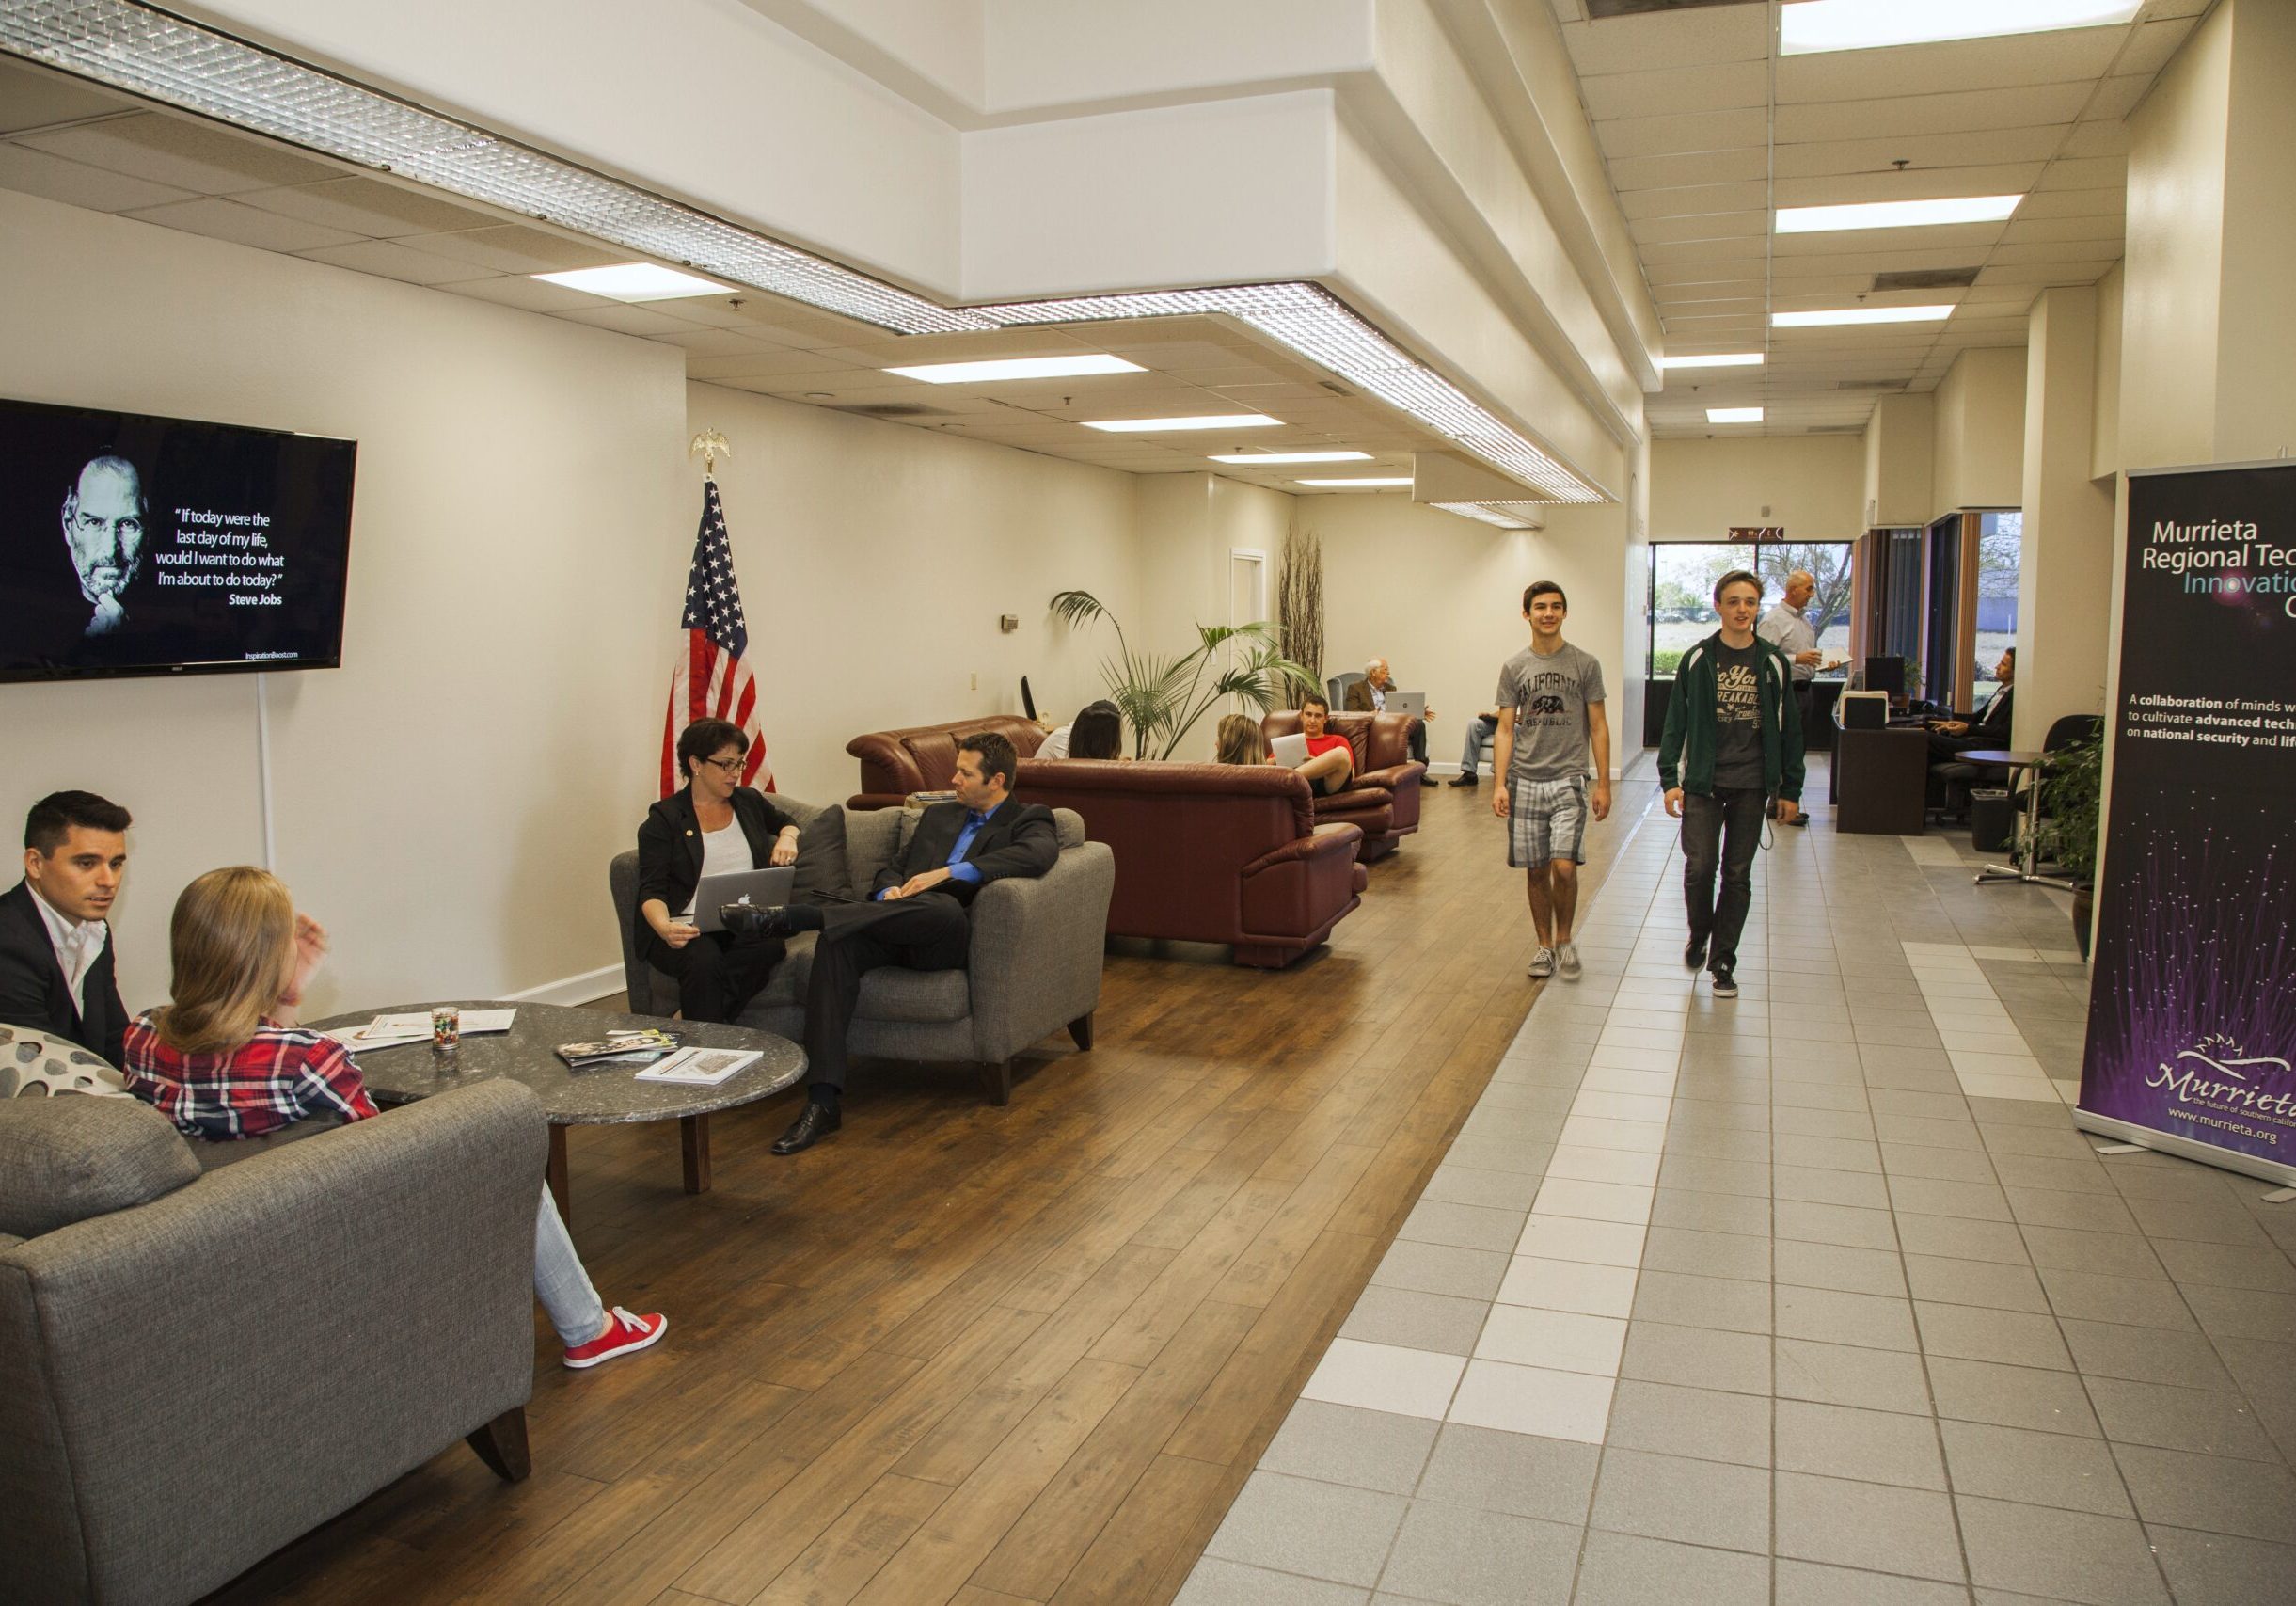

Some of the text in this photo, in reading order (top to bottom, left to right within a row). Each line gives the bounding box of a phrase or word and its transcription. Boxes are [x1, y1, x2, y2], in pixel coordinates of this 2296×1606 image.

[191, 509, 223, 527] today
[225, 515, 251, 526] were
[252, 513, 270, 527] the
[176, 529, 268, 549] last day of my life,
[2152, 519, 2258, 543] Murrieta
[155, 550, 284, 566] would I want to do what
[2142, 544, 2249, 574] Regional
[158, 572, 175, 585] I'm
[177, 571, 211, 586] about
[213, 574, 224, 586] to
[226, 572, 240, 586] do
[229, 593, 282, 605] Steve Jobs
[1717, 692, 1760, 705] REAKABL
[2129, 694, 2137, 705] A
[2139, 694, 2223, 709] collaboration
[2225, 698, 2240, 710] of
[2241, 700, 2281, 712] minds
[2128, 711, 2296, 730] to cultivate advanced tech
[2127, 727, 2296, 748] on national security and lif
[2193, 1098, 2206, 1106] the
[2207, 1100, 2229, 1111] future
[2240, 1108, 2272, 1122] southern
[2168, 1107, 2277, 1145] www.murrieta.org
